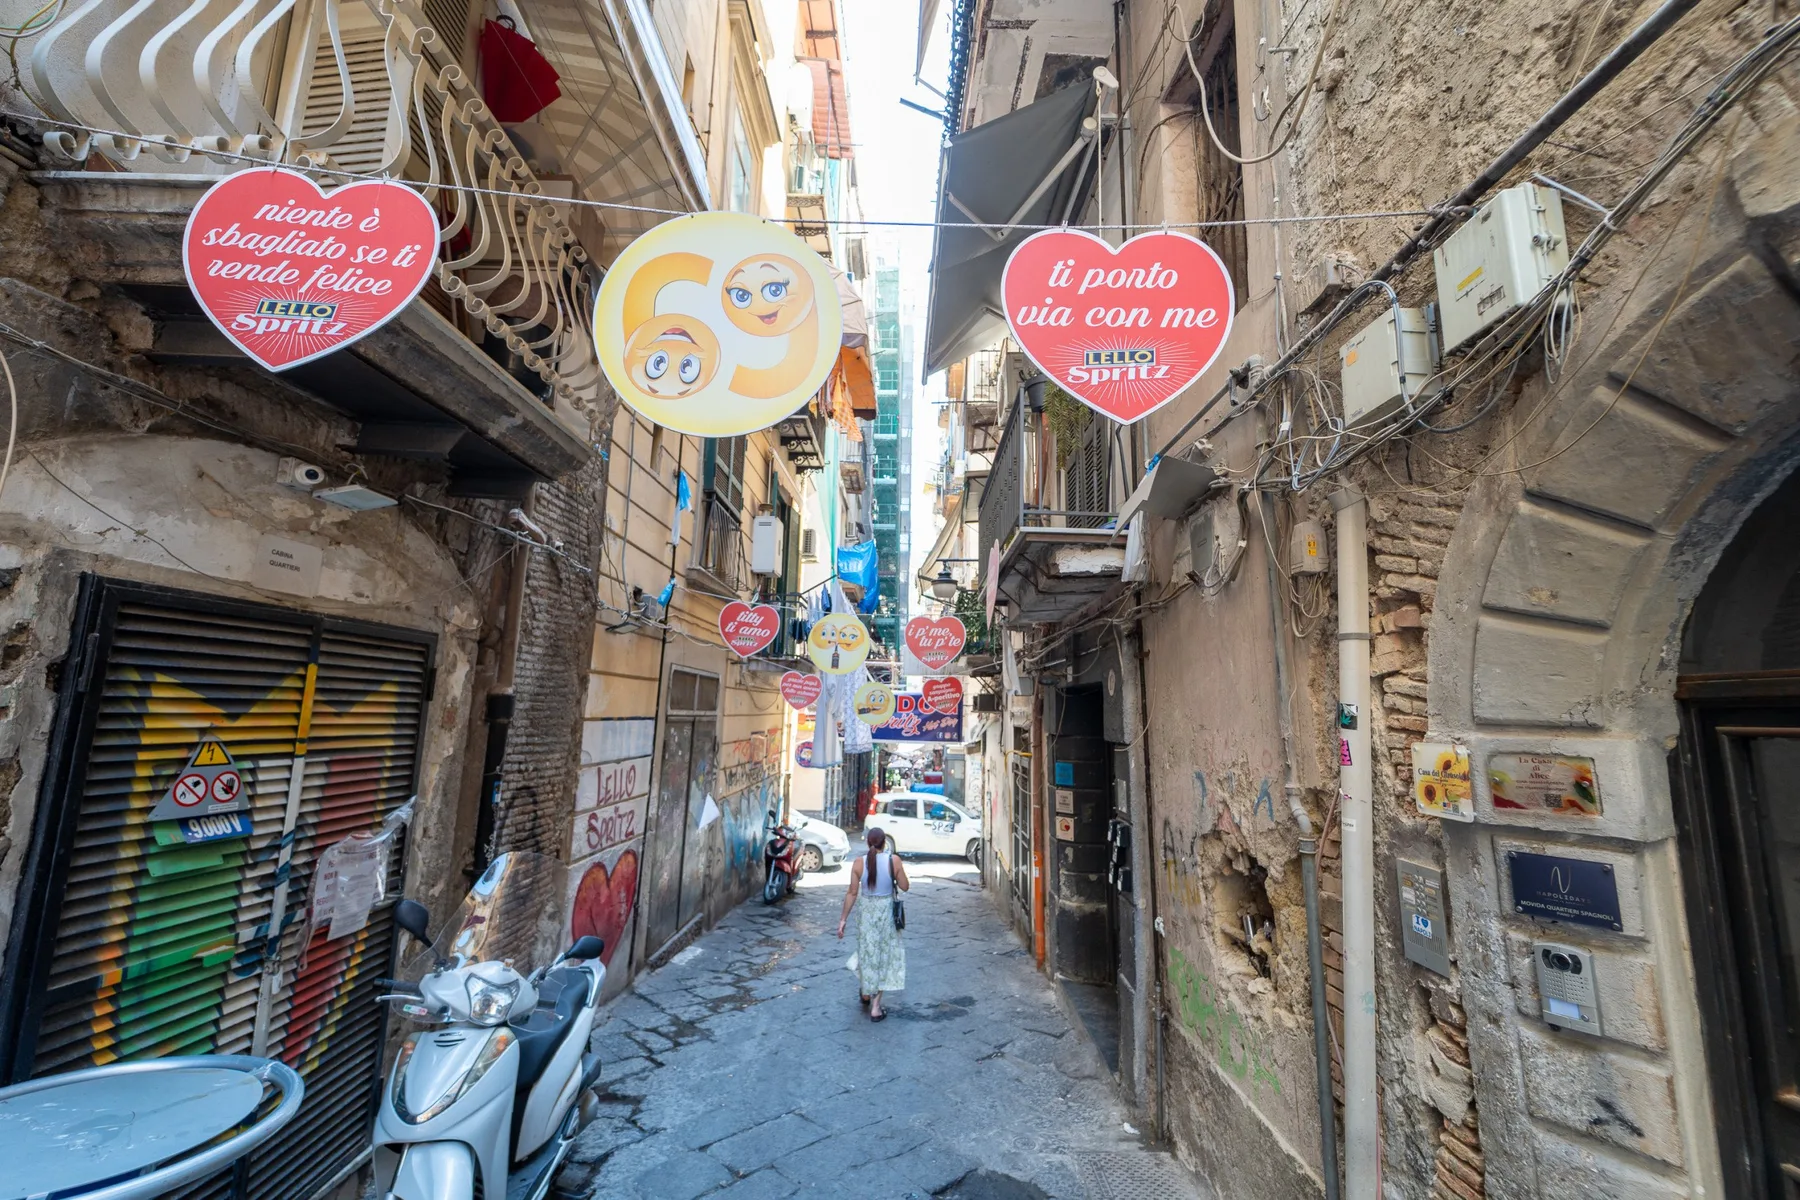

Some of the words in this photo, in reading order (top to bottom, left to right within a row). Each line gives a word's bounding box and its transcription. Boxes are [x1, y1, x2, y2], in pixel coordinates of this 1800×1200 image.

[253, 199, 353, 229] niente
[359, 207, 380, 232] è
[202, 222, 347, 260] sbagliato
[350, 245, 388, 264] se
[392, 244, 422, 268] ti
[207, 259, 300, 286] rende
[298, 264, 392, 296] felice
[1048, 258, 1076, 288] ti
[1077, 261, 1179, 295] porto
[259, 299, 333, 318] LELLO
[1016, 297, 1075, 327] via
[1085, 306, 1153, 328] con
[1159, 306, 1219, 329] me
[231, 312, 348, 335] Spritz
[1087, 349, 1153, 365] LELLO
[1067, 363, 1171, 386] Spritz
[271, 548, 294, 560] CABINA
[725, 621, 738, 633] ti
[739, 626, 771, 638] amo
[1417, 767, 1431, 776] Casa
[597, 764, 636, 807] LELLO
[228, 813, 242, 832] V
[1520, 899, 1546, 909] MOVIDA
[1546, 904, 1580, 915] QUARTIERI
[1580, 910, 1615, 921] SPAGNOLI
